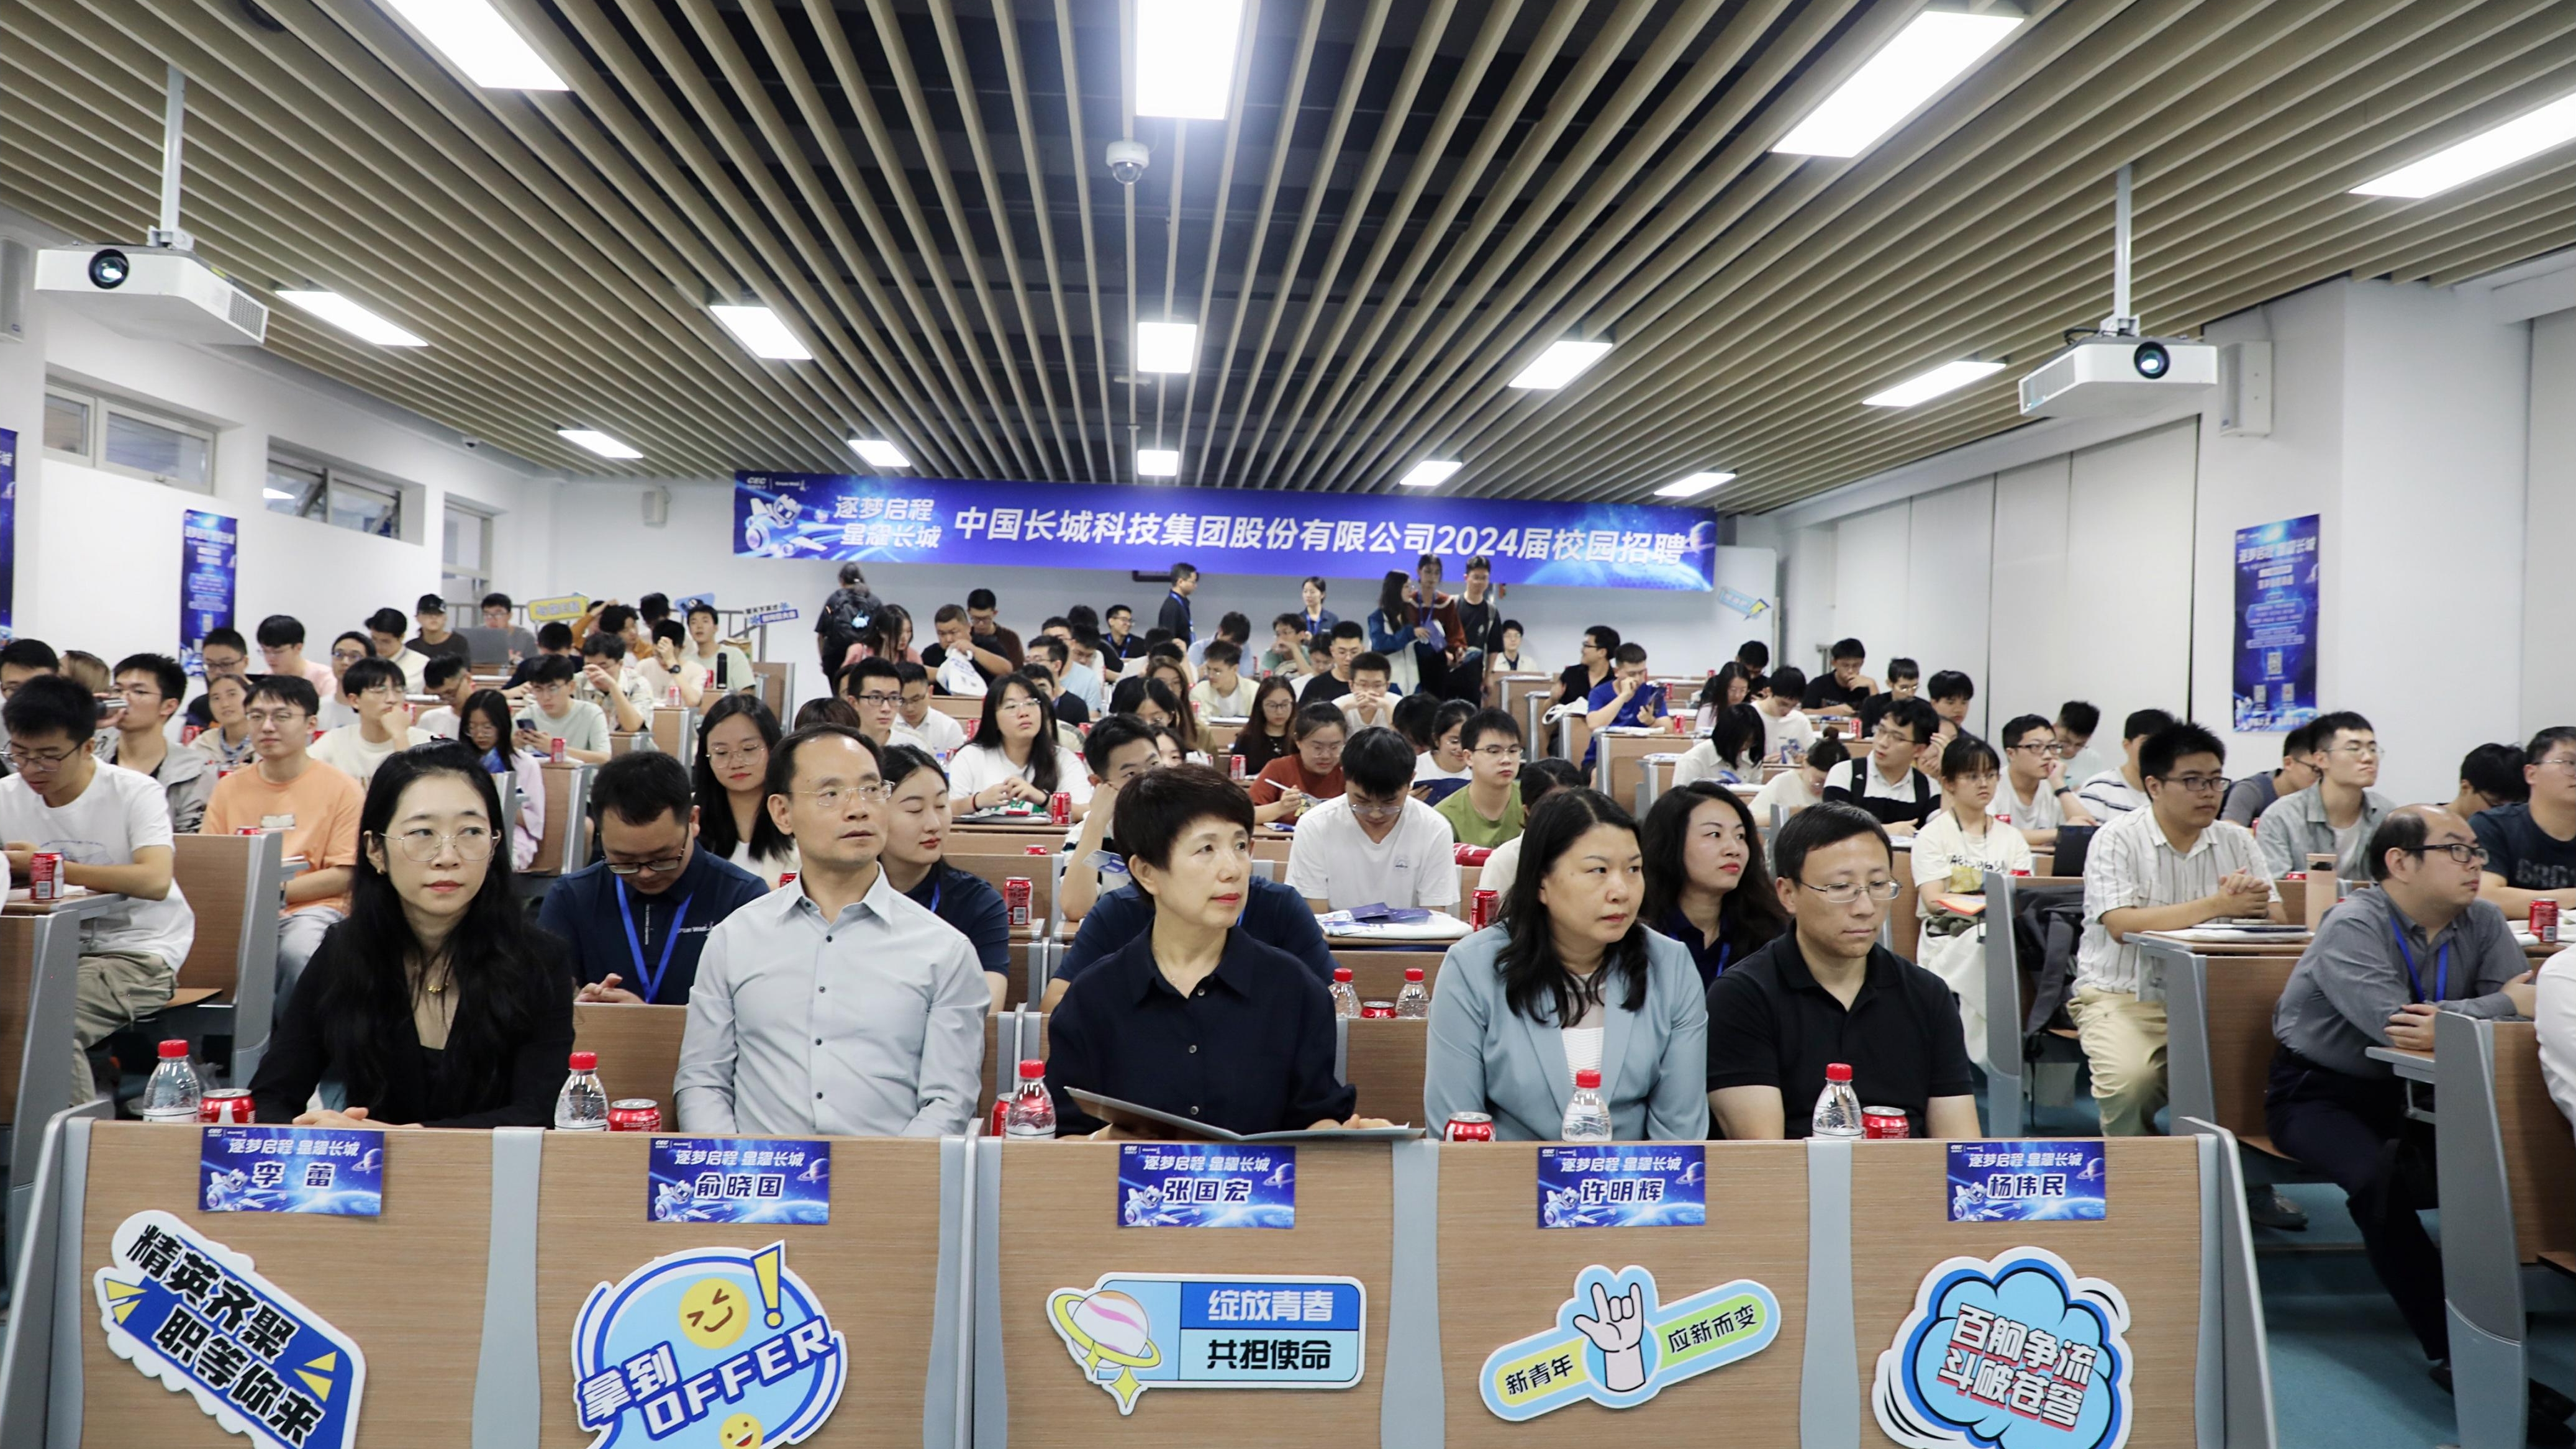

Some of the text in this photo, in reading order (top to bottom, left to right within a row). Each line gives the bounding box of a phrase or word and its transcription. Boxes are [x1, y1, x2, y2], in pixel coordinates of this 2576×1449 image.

[834, 495, 935, 521] 逐梦启程
[840, 523, 941, 548] 星耀长城
[954, 506, 1685, 565] 中国长城科技集团股份有限公司2024届校园招聘
[228, 1138, 360, 1156] 逐梦启程 星耀长城
[674, 1150, 805, 1167] 逐梦启程 星耀长城
[1969, 1153, 2083, 1168] 逐梦启程 星耀长城
[252, 1161, 336, 1189] 李 蕾
[1143, 1155, 1271, 1171] 逐梦启程 星耀长城
[1560, 1156, 1682, 1172] 逐梦启程 星耀长城
[694, 1173, 785, 1199] 俞晓国
[1163, 1178, 1251, 1204] 张国宏
[1581, 1179, 1664, 1204] 许明辉
[1987, 1174, 2066, 1198] 杨伟民
[126, 1224, 296, 1363] 精英齐聚
[1208, 1289, 1333, 1322] 绽放青春
[1669, 1304, 1758, 1354] 应新而变
[1208, 1340, 1331, 1370] 共担使命
[1951, 1302, 2098, 1388] 百舸争流
[153, 1305, 324, 1448] 职等你来
[582, 1345, 677, 1421] 拿到
[643, 1318, 831, 1436] OFFER
[1505, 1354, 1574, 1395] 新青年
[1938, 1344, 2084, 1429] 斗破苍穹
